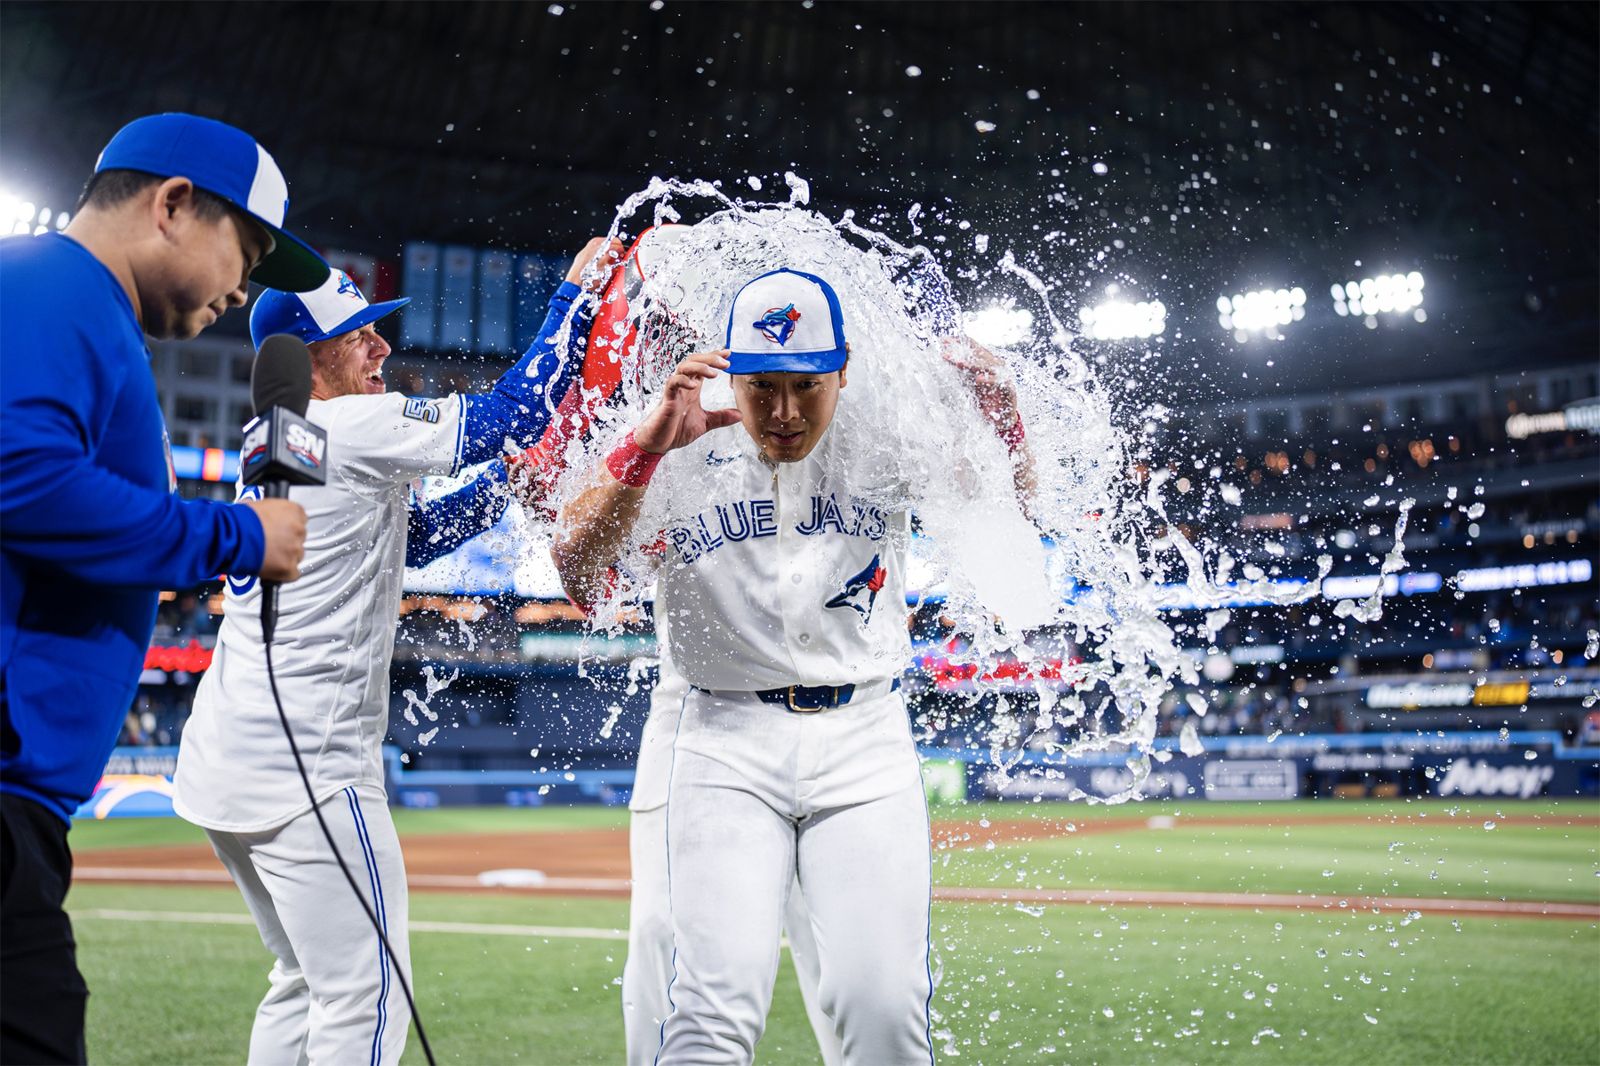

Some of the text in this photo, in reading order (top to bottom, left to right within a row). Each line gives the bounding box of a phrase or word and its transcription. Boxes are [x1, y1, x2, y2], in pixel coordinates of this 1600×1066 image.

[286, 423, 325, 461] SN
[670, 492, 888, 564] BLUE JAYS
